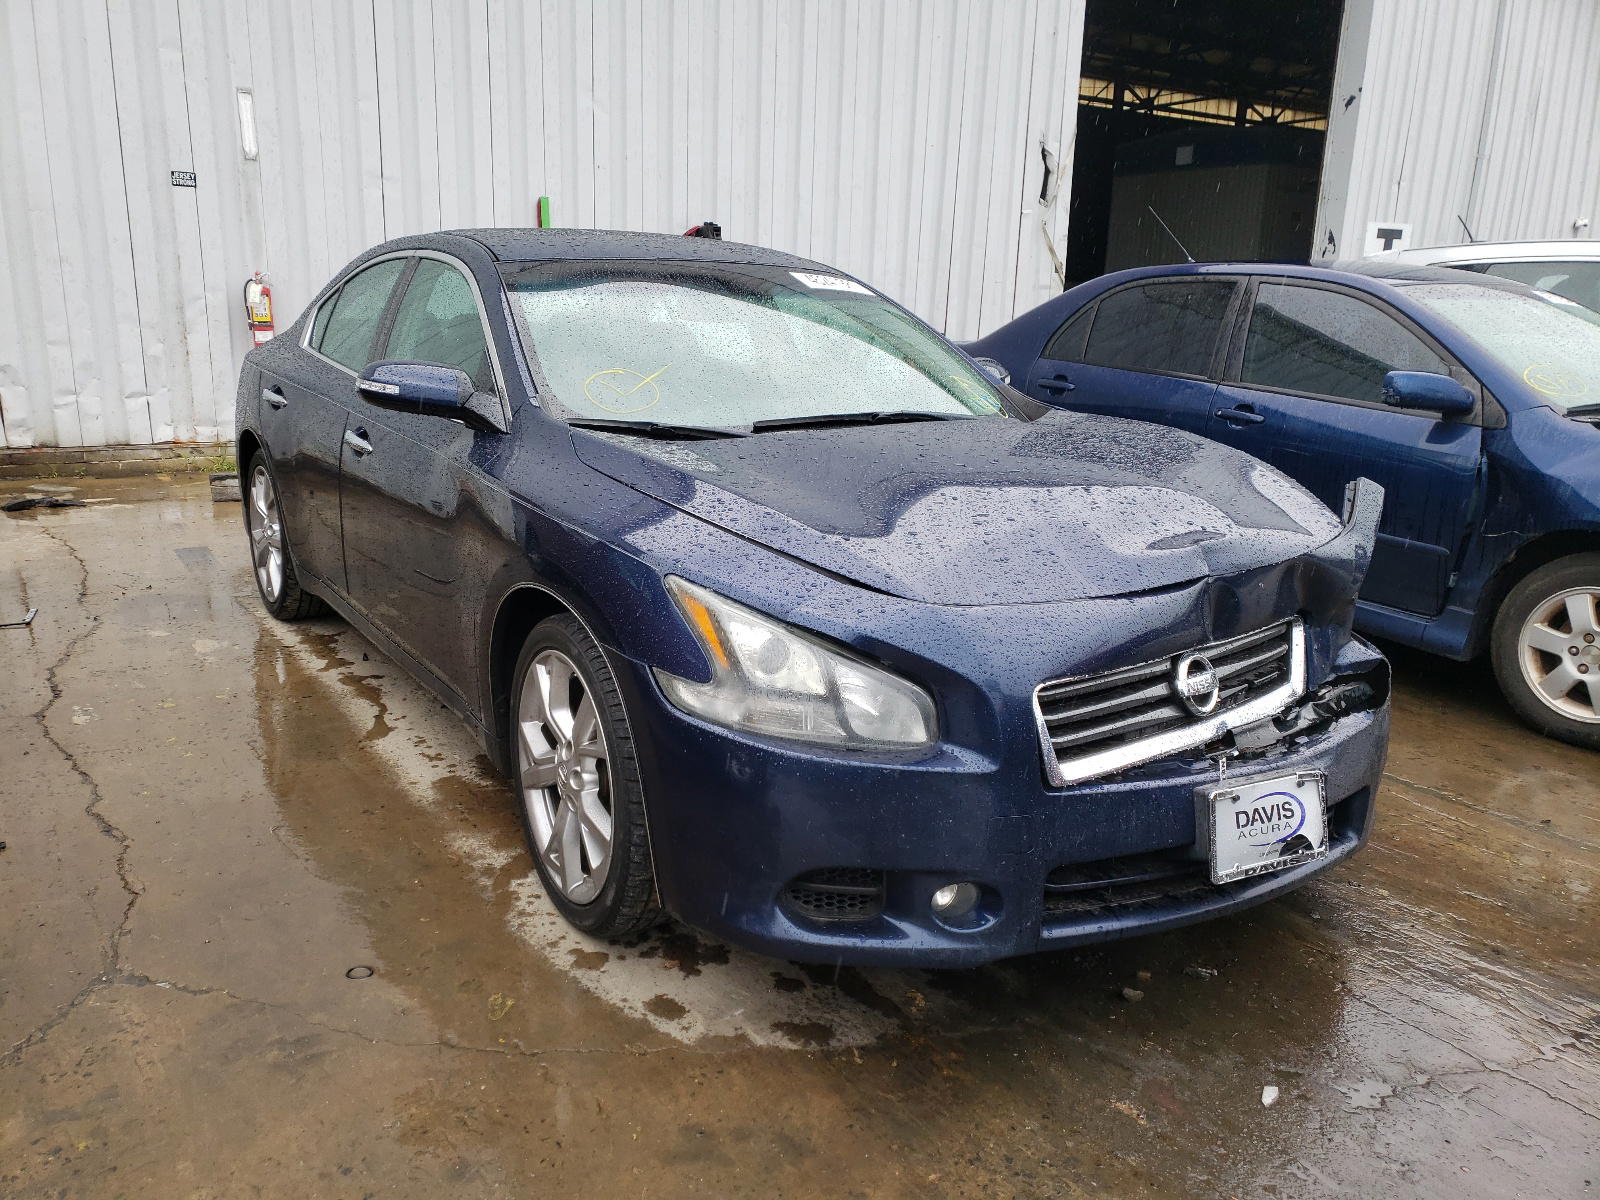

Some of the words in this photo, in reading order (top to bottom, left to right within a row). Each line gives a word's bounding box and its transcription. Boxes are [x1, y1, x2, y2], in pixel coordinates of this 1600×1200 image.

[171, 171, 195, 180] JERSEY
[1377, 228, 1402, 251] T
[1235, 801, 1295, 829] DAVIS
[1238, 821, 1293, 840] ACURA
